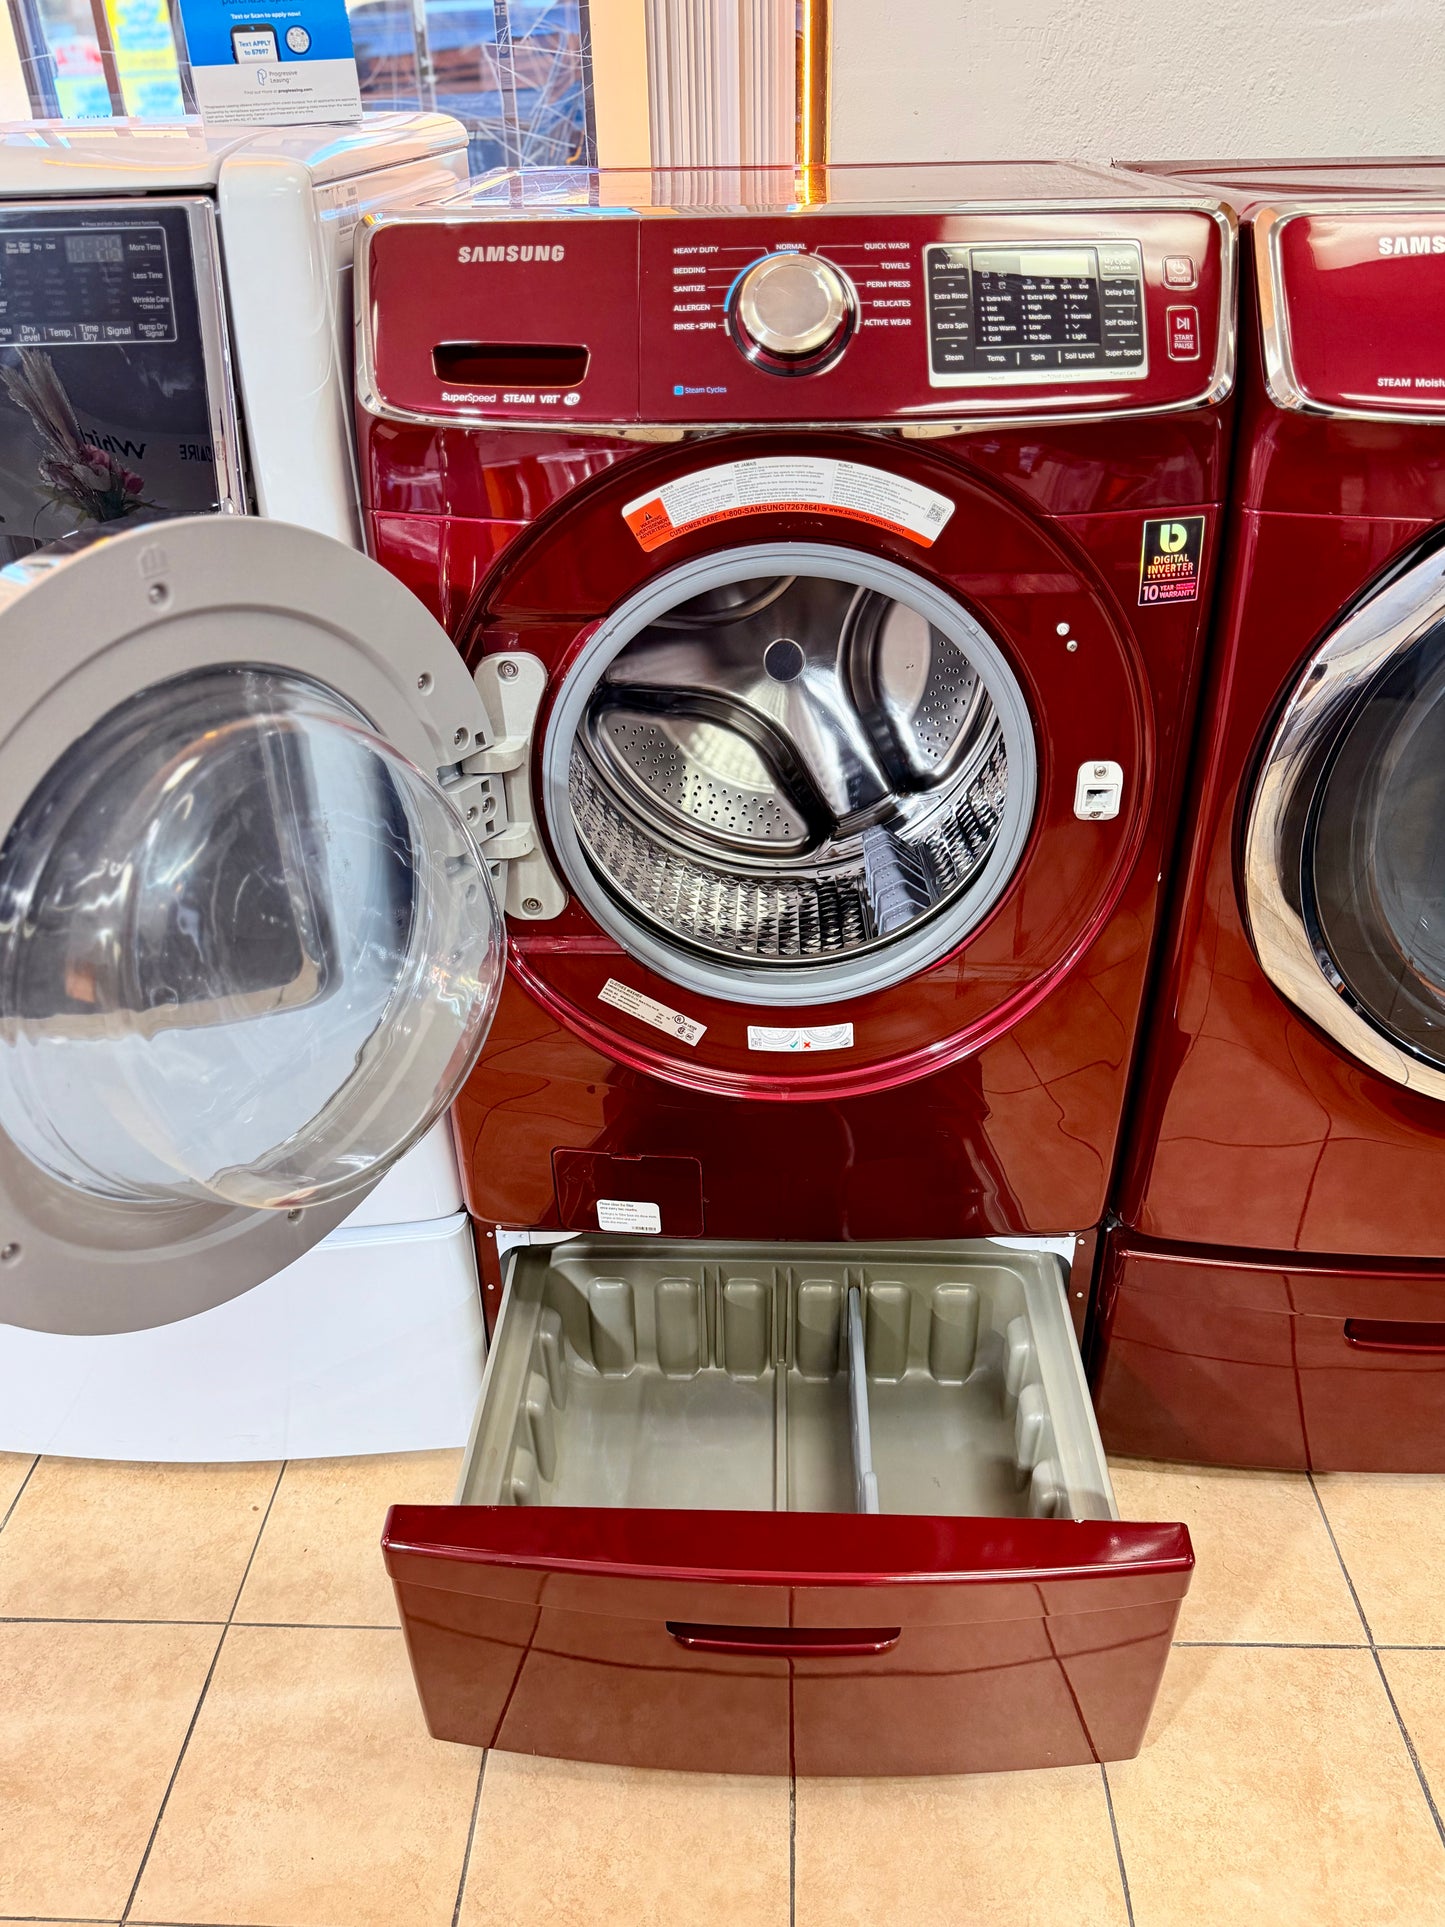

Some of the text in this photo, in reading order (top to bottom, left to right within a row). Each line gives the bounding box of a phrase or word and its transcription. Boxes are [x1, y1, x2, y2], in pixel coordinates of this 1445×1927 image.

[271, 11, 287, 19] apply
[33, 243, 42, 251] Dry
[864, 242, 887, 250] QUICK
[1378, 236, 1445, 254] SAMS
[458, 245, 565, 263] SAMSUNG
[673, 247, 698, 255] HEAVY
[1115, 257, 1130, 267] Cycle
[673, 285, 706, 293] SANITIZE
[673, 304, 711, 312] ALLERGEN
[21, 325, 36, 334] Dry
[79, 324, 99, 333] Time
[156, 323, 168, 331] Dry
[954, 322, 969, 330] Spin
[49, 328, 72, 338] Temp.
[107, 326, 131, 336] Signal
[145, 330, 164, 338] Signal
[19, 333, 41, 342] Level
[83, 332, 97, 342] Dry
[1031, 353, 1045, 361] Spin
[1123, 349, 1142, 357] Speed
[1377, 378, 1411, 388] STEAM
[685, 386, 727, 394] Steam Cycles
[441, 392, 496, 403] SuperSpeed
[503, 393, 535, 403] STEAM
[660, 484, 674, 493] NEVER
[670, 520, 702, 538] CUSTOMER
[702, 515, 721, 525] CARE:
[829, 508, 905, 534] www.samsung.com/support
[1153, 553, 1189, 565] DIGITAL
[1147, 562, 1194, 574] INVERTER
[1142, 585, 1159, 601] 10
[1159, 589, 1195, 599] WARRANTY
